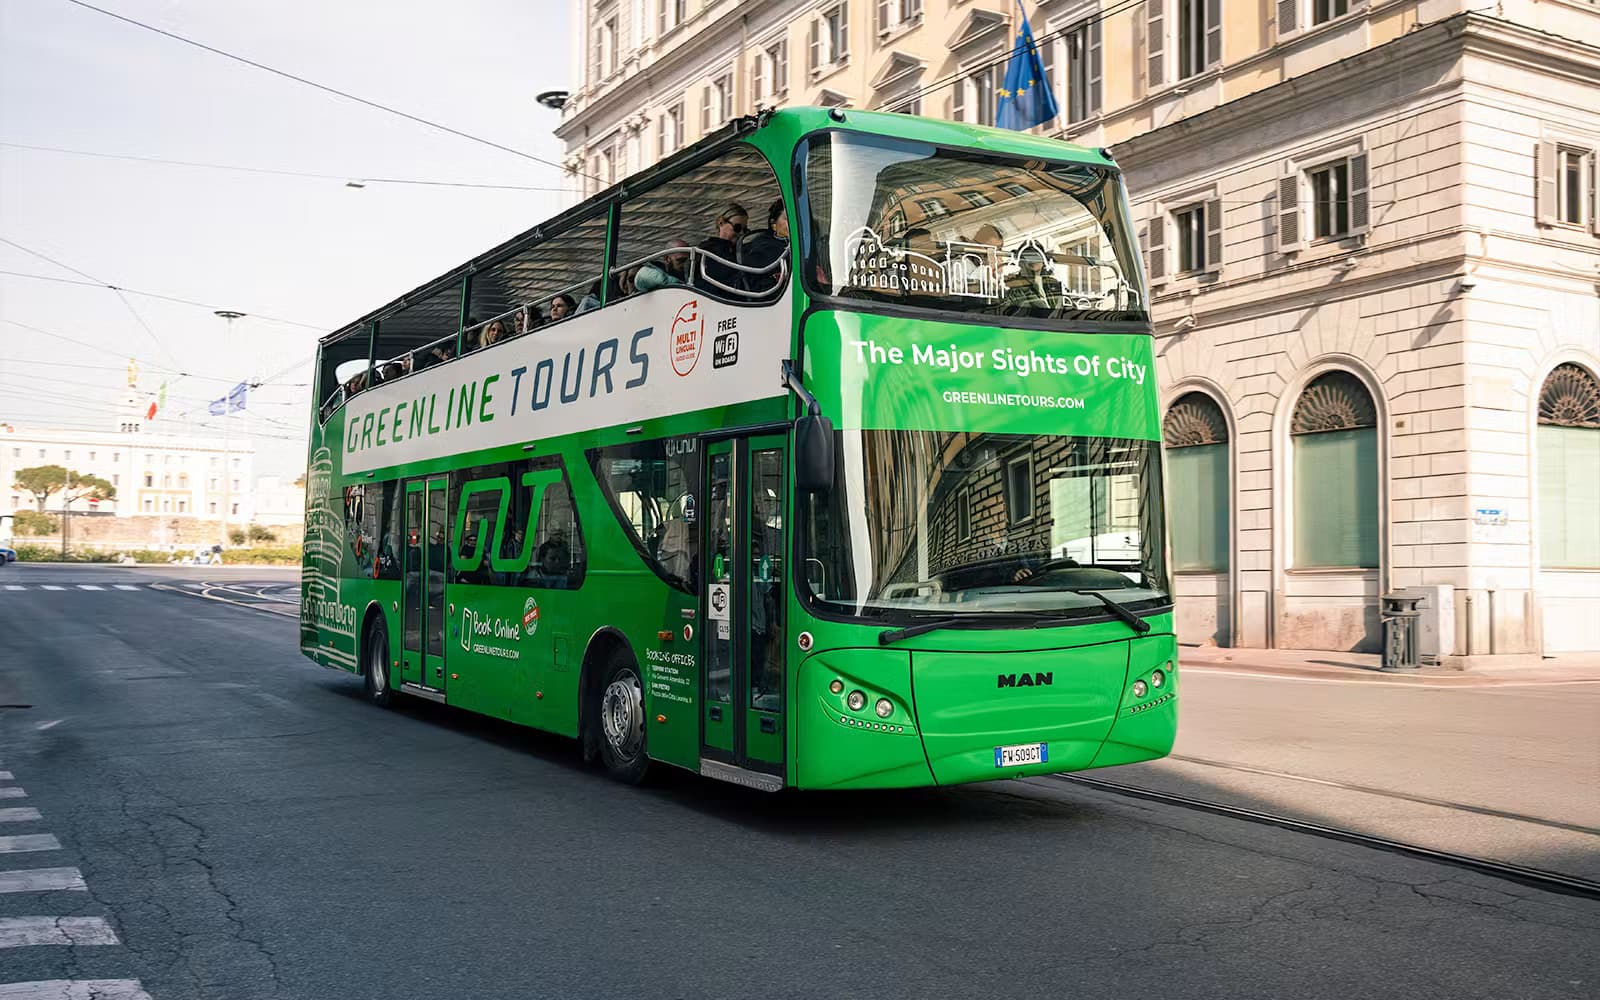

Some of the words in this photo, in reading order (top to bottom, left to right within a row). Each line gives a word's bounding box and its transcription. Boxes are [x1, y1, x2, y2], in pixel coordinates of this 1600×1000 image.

[717, 317, 737, 332] FREE
[676, 331, 697, 345] MULTI
[721, 355, 737, 364] BOARD
[850, 340, 904, 365] The
[911, 343, 985, 374] Major
[991, 347, 1068, 377] Sights
[1073, 354, 1100, 377] Of
[1106, 356, 1147, 385] City
[346, 373, 500, 453] GREENLINE
[510, 326, 654, 416] TOURS
[942, 390, 1085, 409] GREENLINETOURS.COM
[473, 611, 492, 636] Book
[494, 618, 520, 641] Online
[646, 648, 670, 662] BOOKING
[671, 653, 695, 667] OFFICES
[997, 672, 1053, 688] MAN
